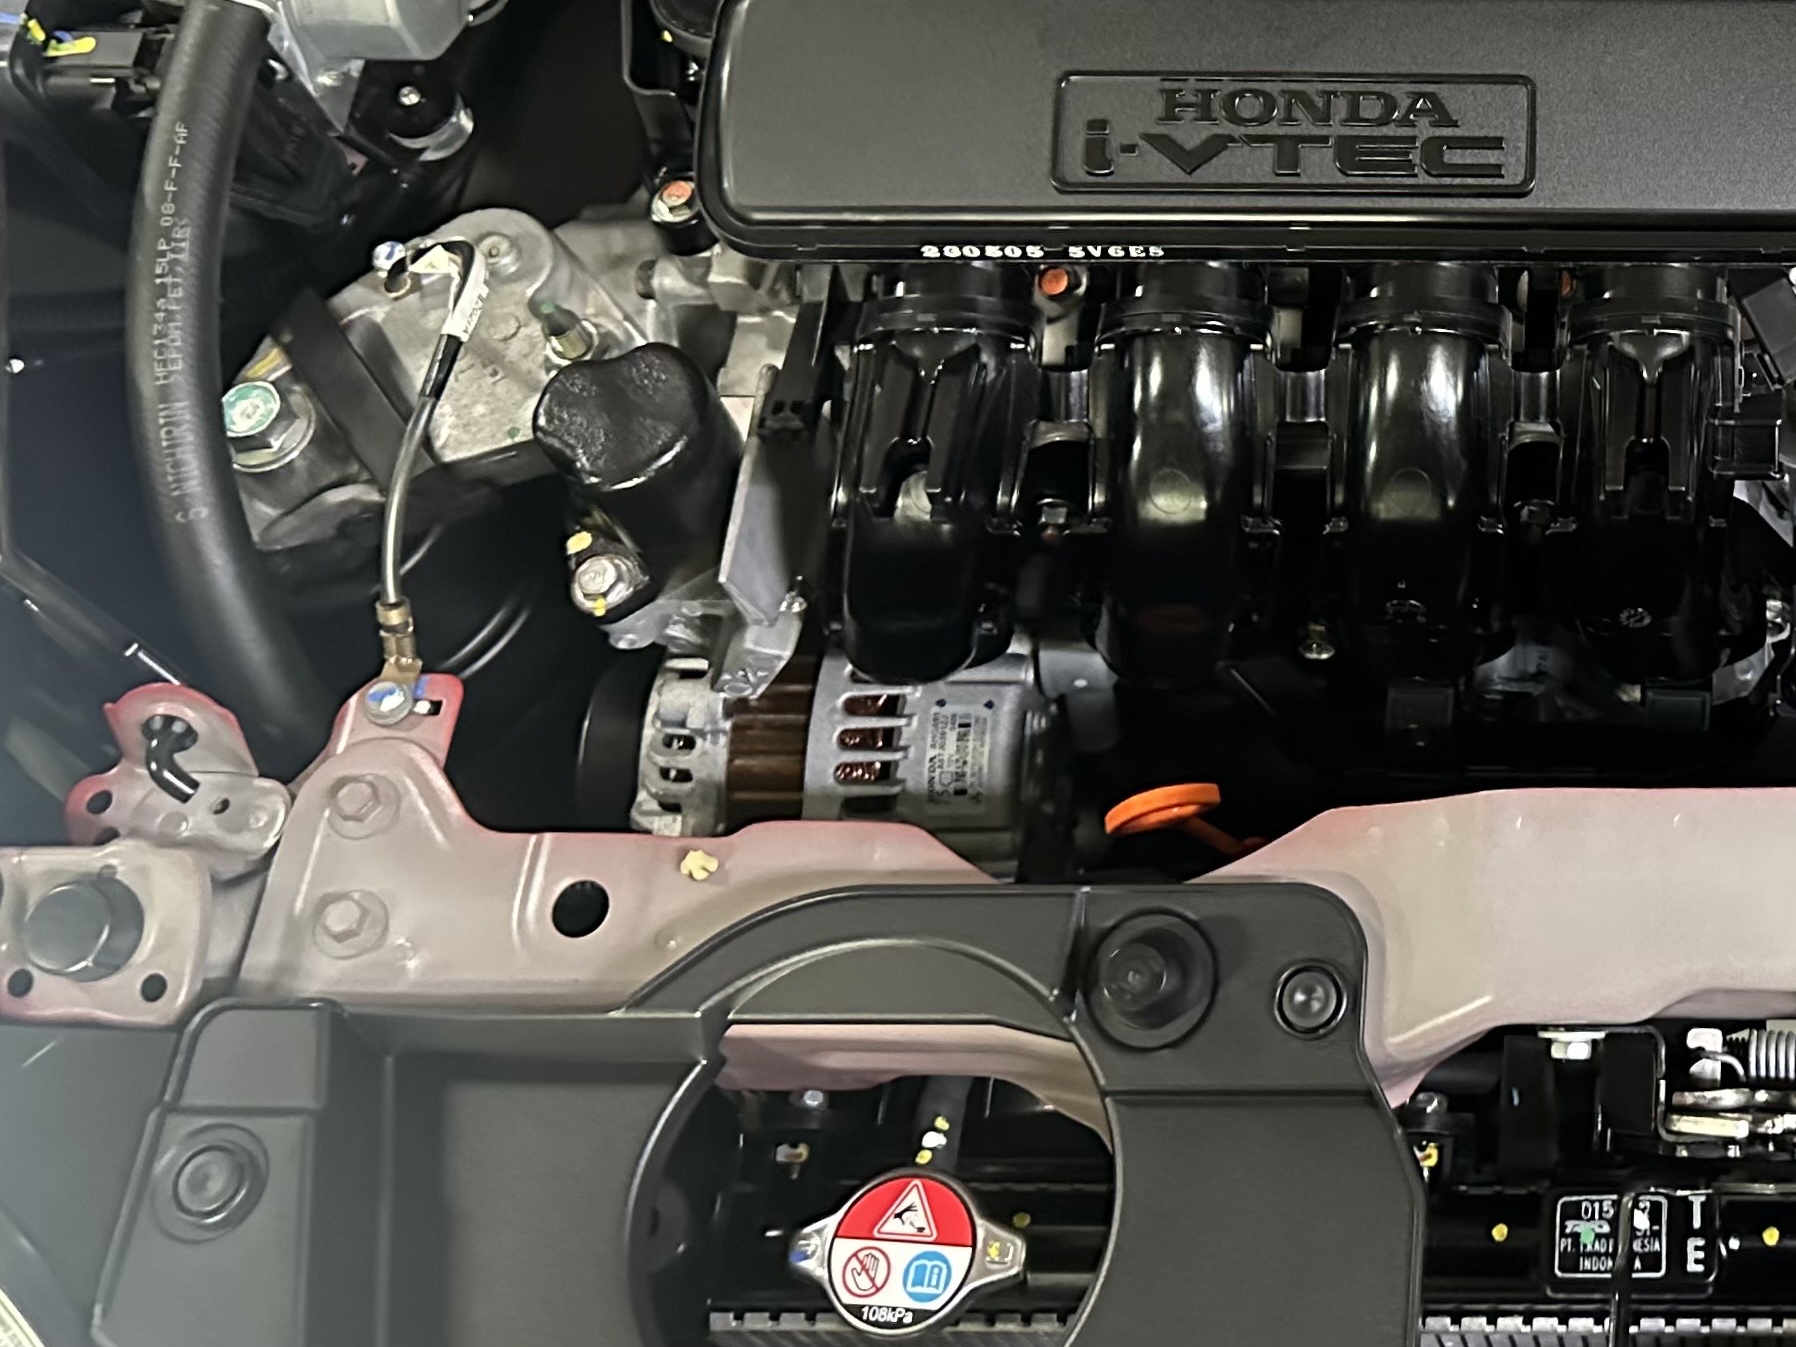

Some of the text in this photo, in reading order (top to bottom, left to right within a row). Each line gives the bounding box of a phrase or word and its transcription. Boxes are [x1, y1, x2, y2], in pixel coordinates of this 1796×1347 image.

[1157, 88, 1459, 128] HONDA
[1083, 119, 1506, 178] i-VTEC
[860, 1305, 914, 1324] 108kPa
